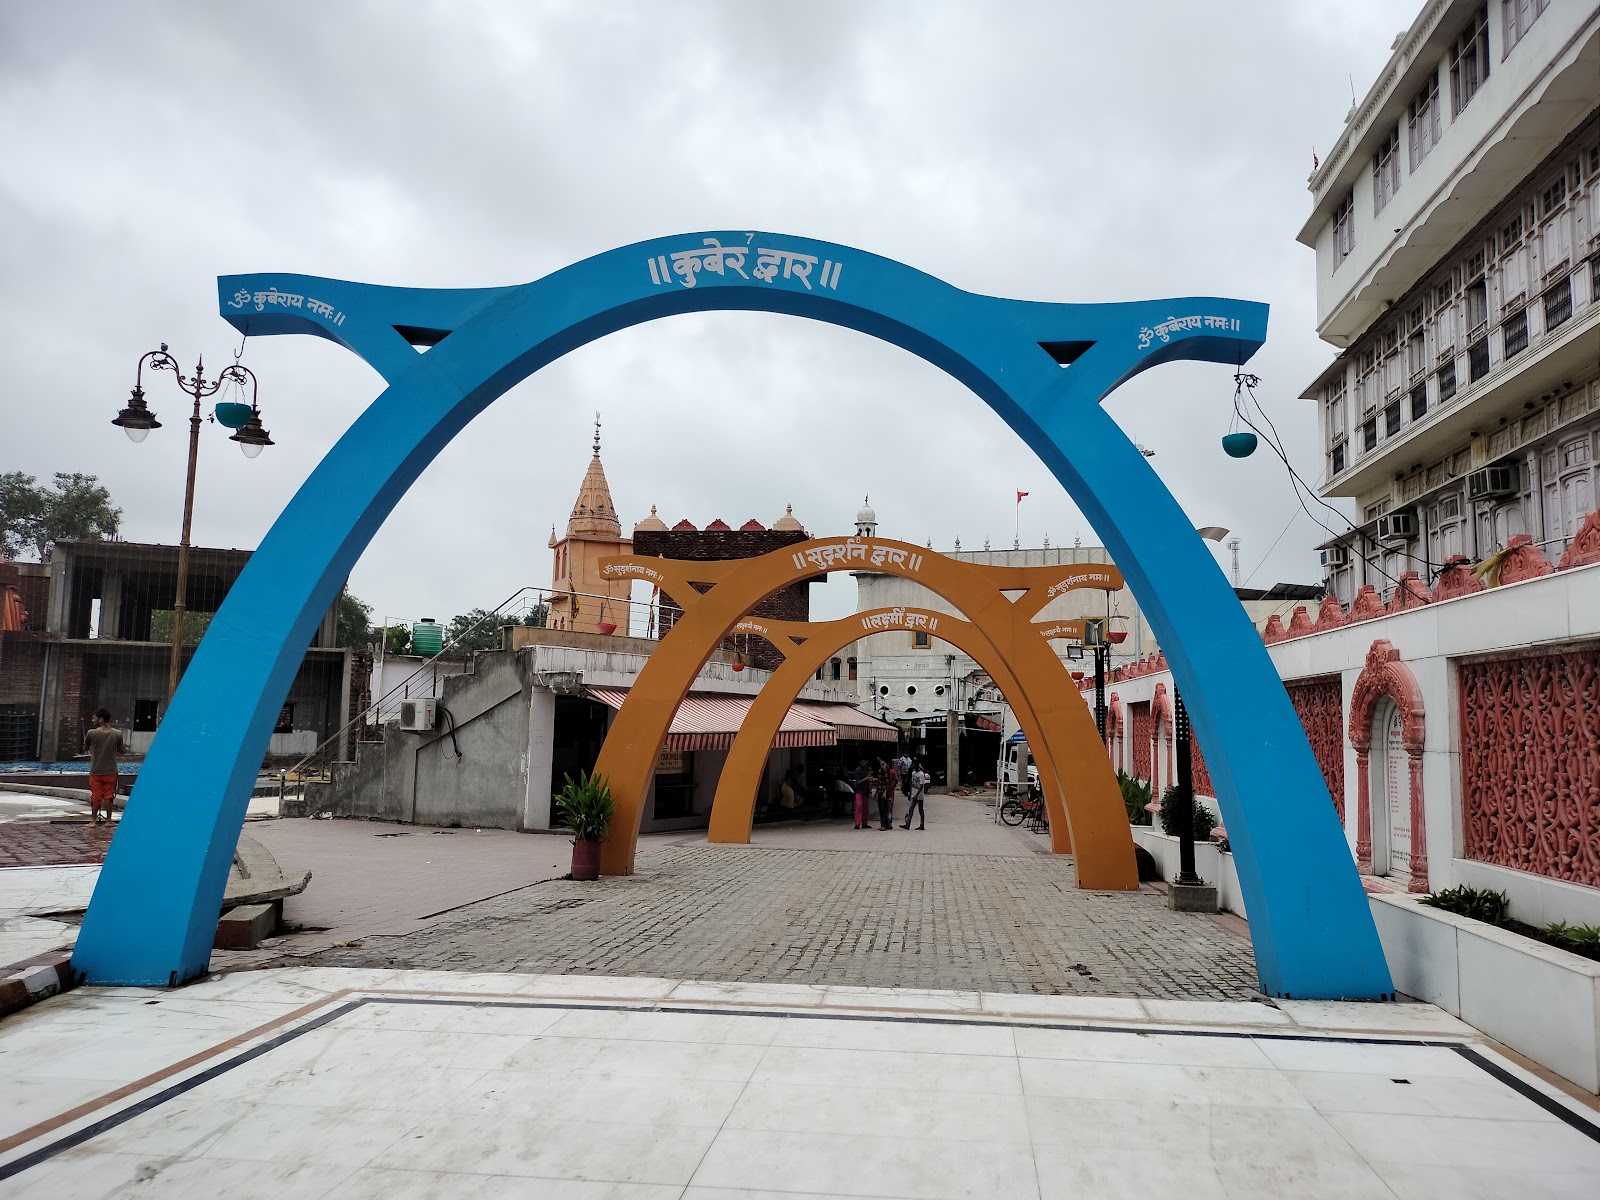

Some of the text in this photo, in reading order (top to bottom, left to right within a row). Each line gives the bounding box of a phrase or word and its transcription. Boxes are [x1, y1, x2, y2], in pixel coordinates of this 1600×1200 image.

[745, 233, 755, 245] 7
[254, 287, 304, 312] कुबेराय
[1153, 316, 1202, 343] कुबेराय
